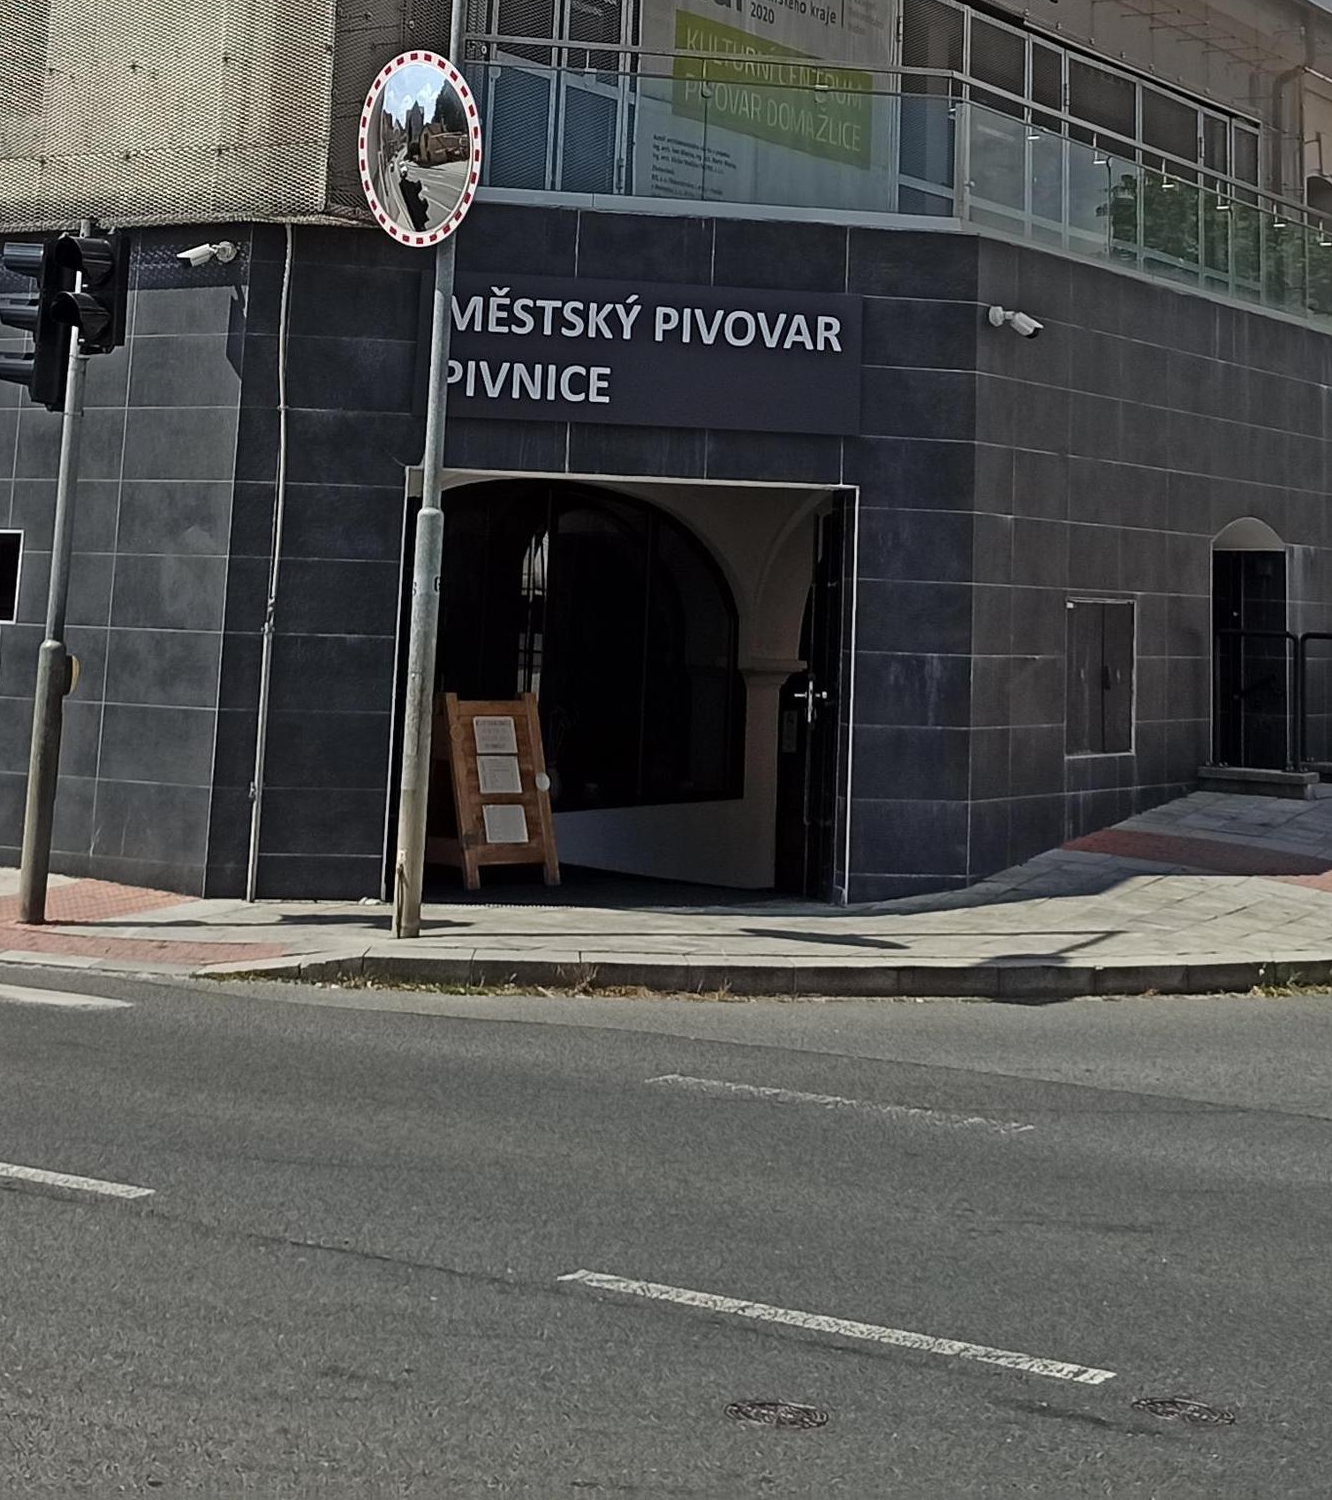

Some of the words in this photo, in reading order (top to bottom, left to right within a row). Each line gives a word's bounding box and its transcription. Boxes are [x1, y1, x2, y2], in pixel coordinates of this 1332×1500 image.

[750, 1, 775, 25] 2020
[810, 1, 837, 27] kraje
[766, 98, 862, 152] DOMAŽLICE
[451, 286, 643, 341] MĚSTSKÝ
[654, 305, 843, 353] PIVOVAR
[446, 360, 612, 404] PIVNICE
